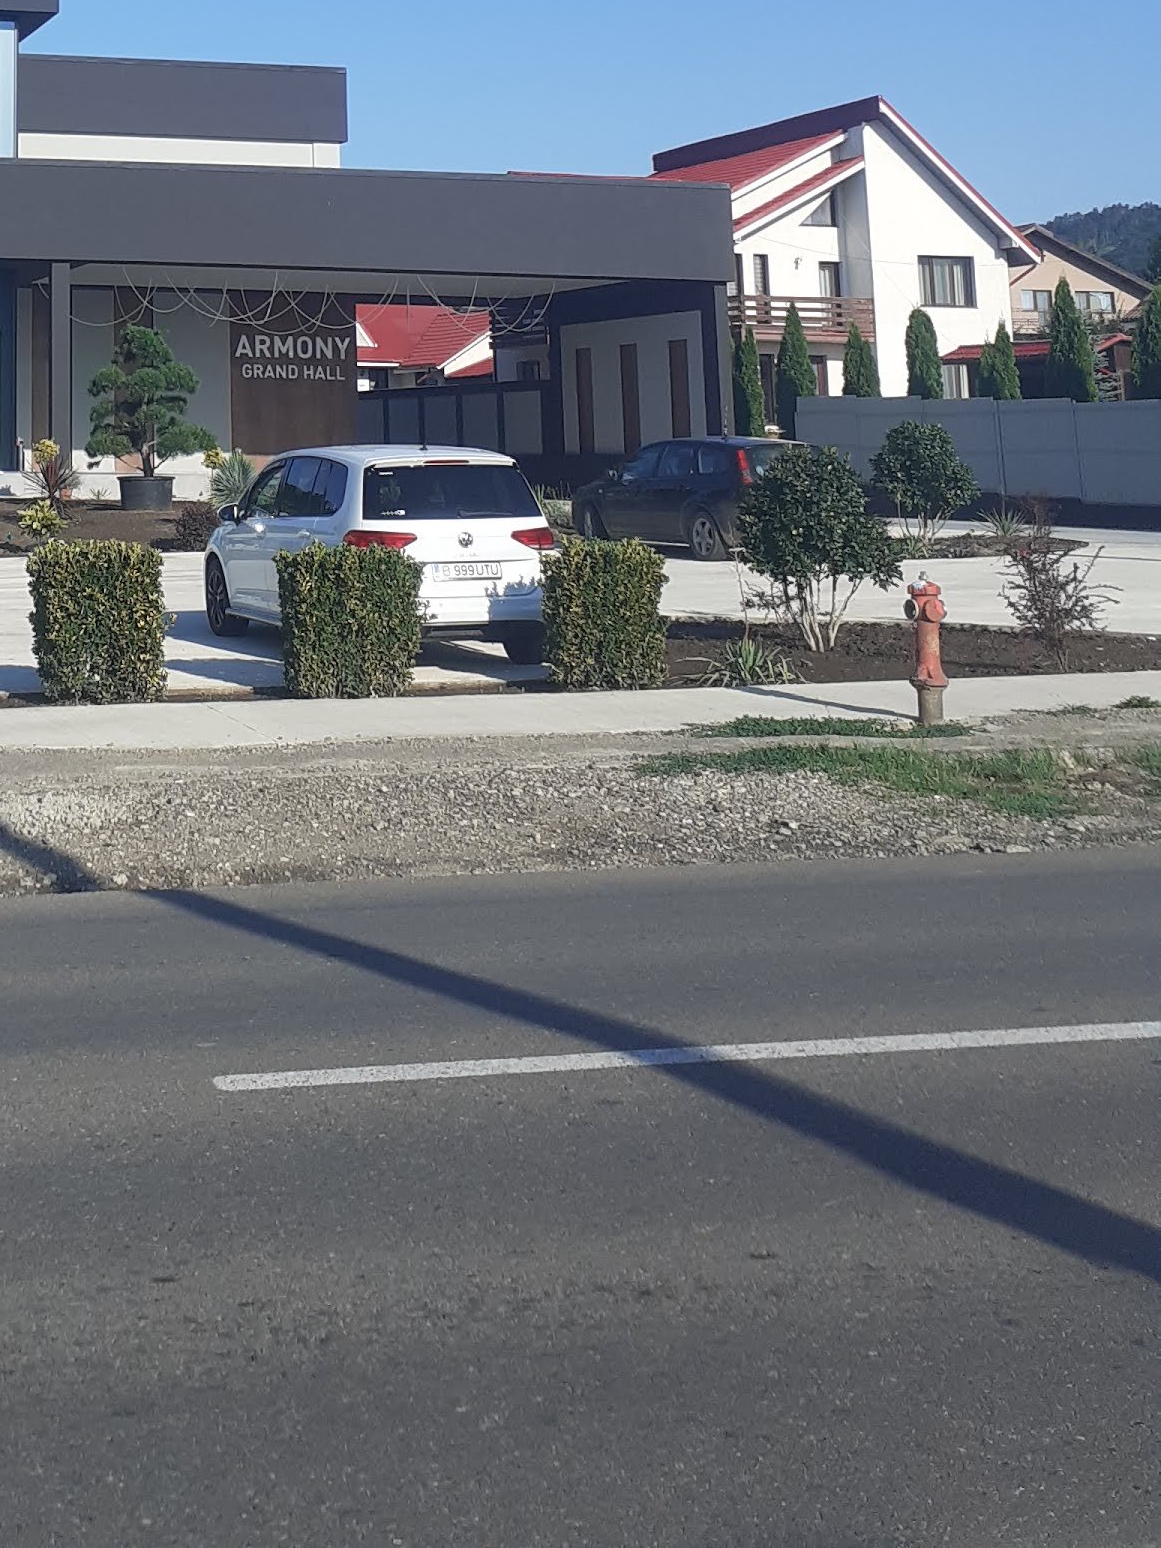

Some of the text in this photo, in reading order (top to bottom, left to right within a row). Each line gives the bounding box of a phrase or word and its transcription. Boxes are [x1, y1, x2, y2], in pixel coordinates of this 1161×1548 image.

[234, 334, 350, 359] ARMONY
[242, 363, 345, 380] GRAND HALL
